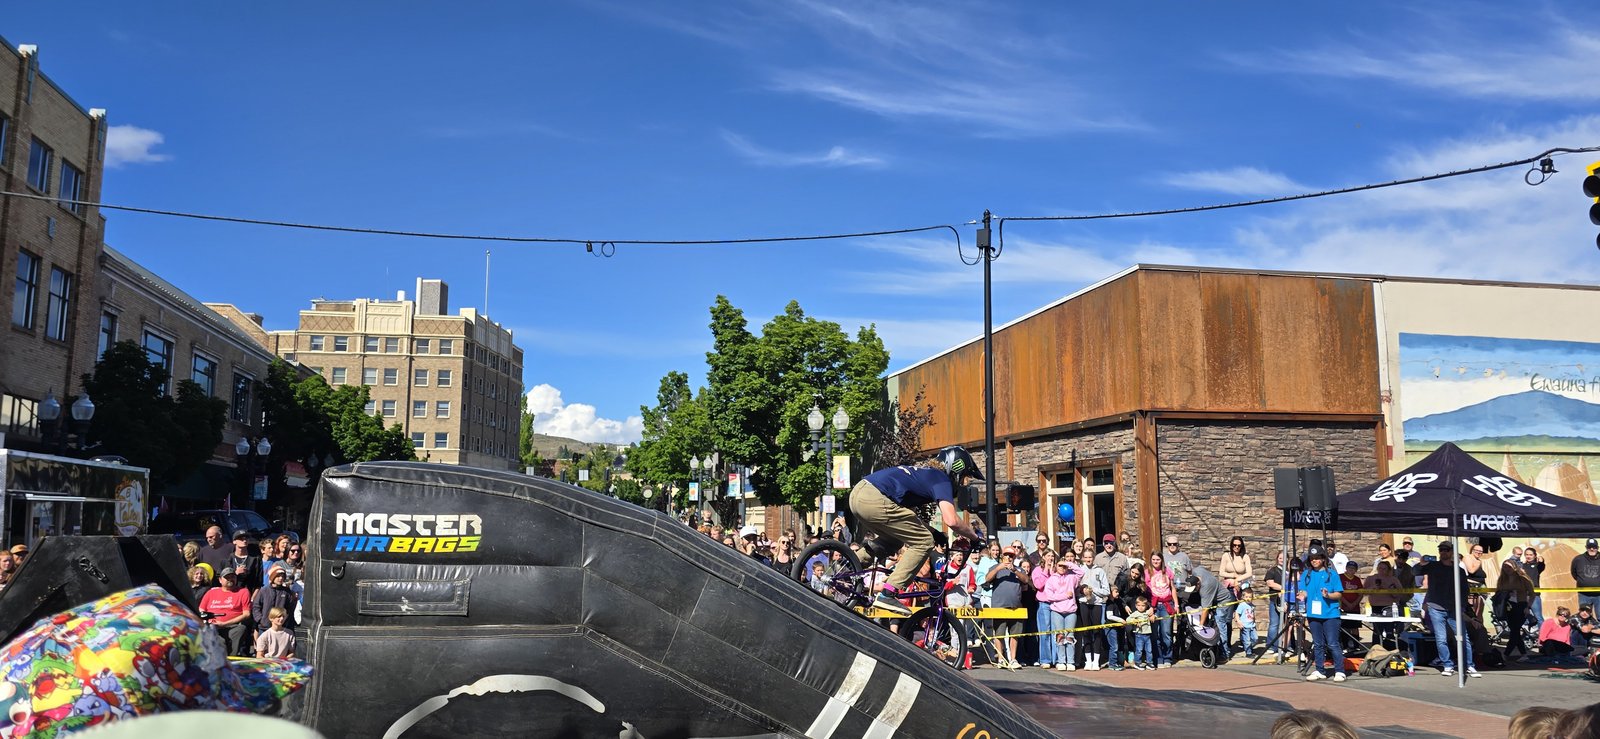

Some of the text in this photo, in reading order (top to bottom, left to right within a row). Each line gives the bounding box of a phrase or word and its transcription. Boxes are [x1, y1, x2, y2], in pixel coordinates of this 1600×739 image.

[336, 512, 482, 536] MASTER
[1463, 514, 1506, 530] HYPER
[334, 535, 482, 553] AIRBAGS
